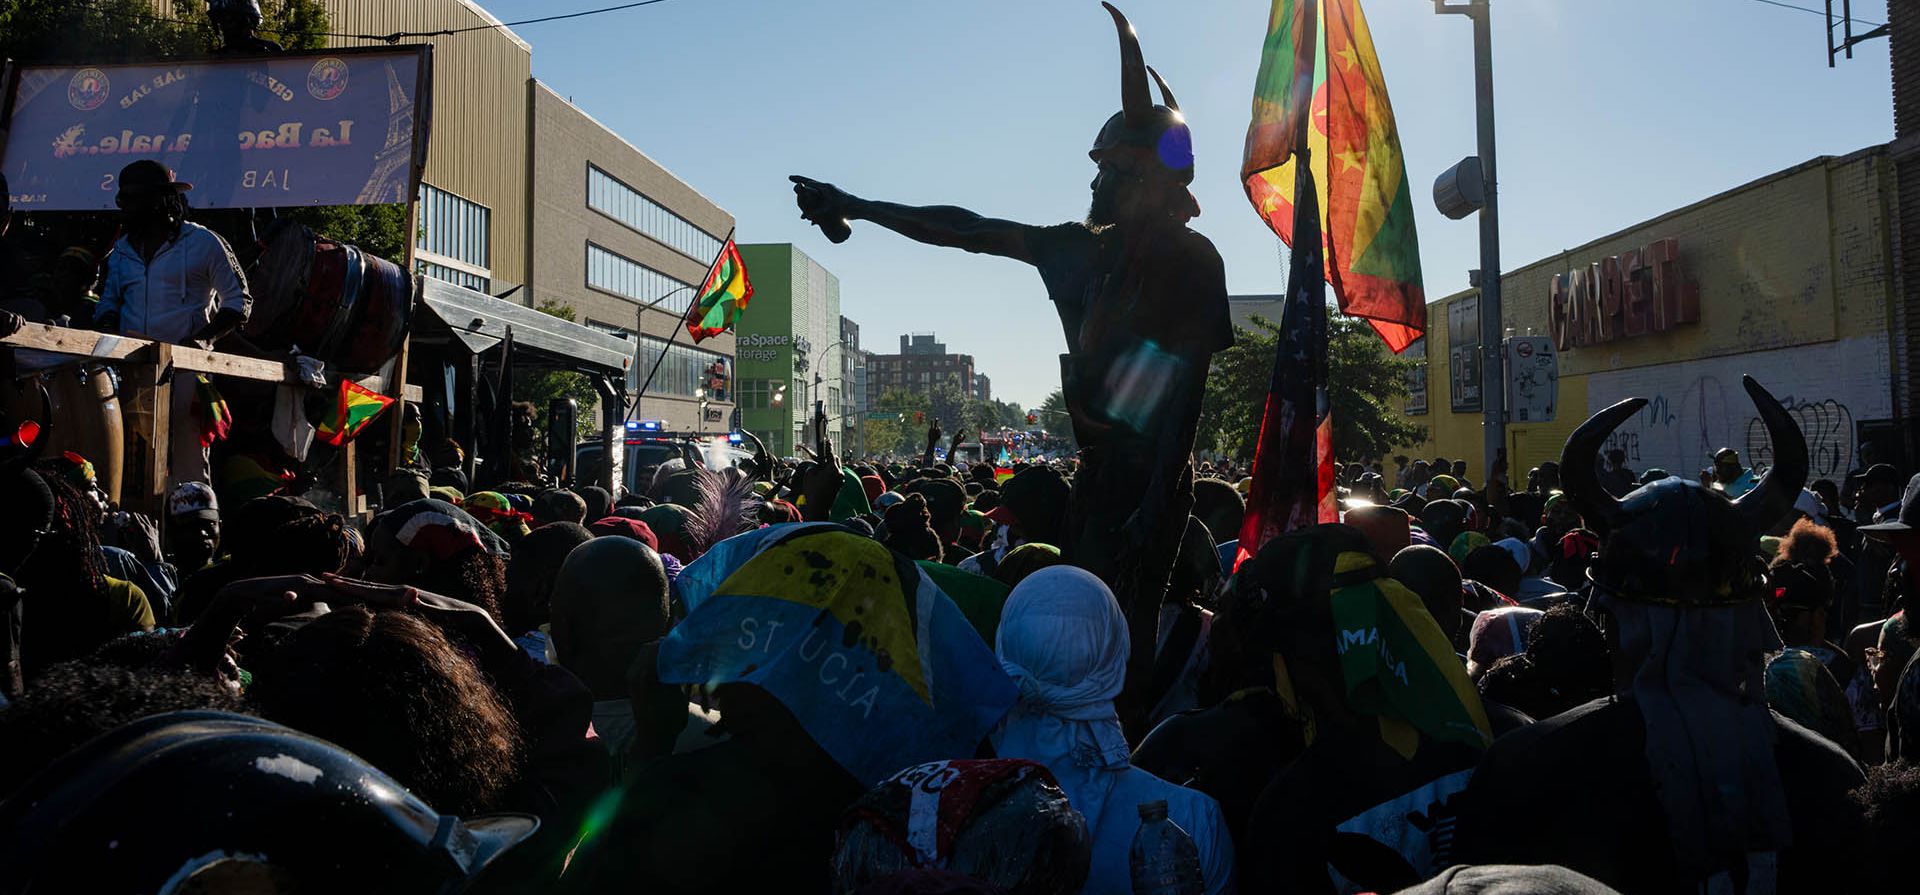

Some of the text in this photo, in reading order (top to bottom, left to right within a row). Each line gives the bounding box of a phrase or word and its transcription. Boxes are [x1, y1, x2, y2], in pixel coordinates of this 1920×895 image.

[1549, 237, 1680, 351] CARPET
[736, 333, 789, 347] raSpace
[737, 617, 879, 719] ST UCIA
[1335, 626, 1409, 688] AMAICA
